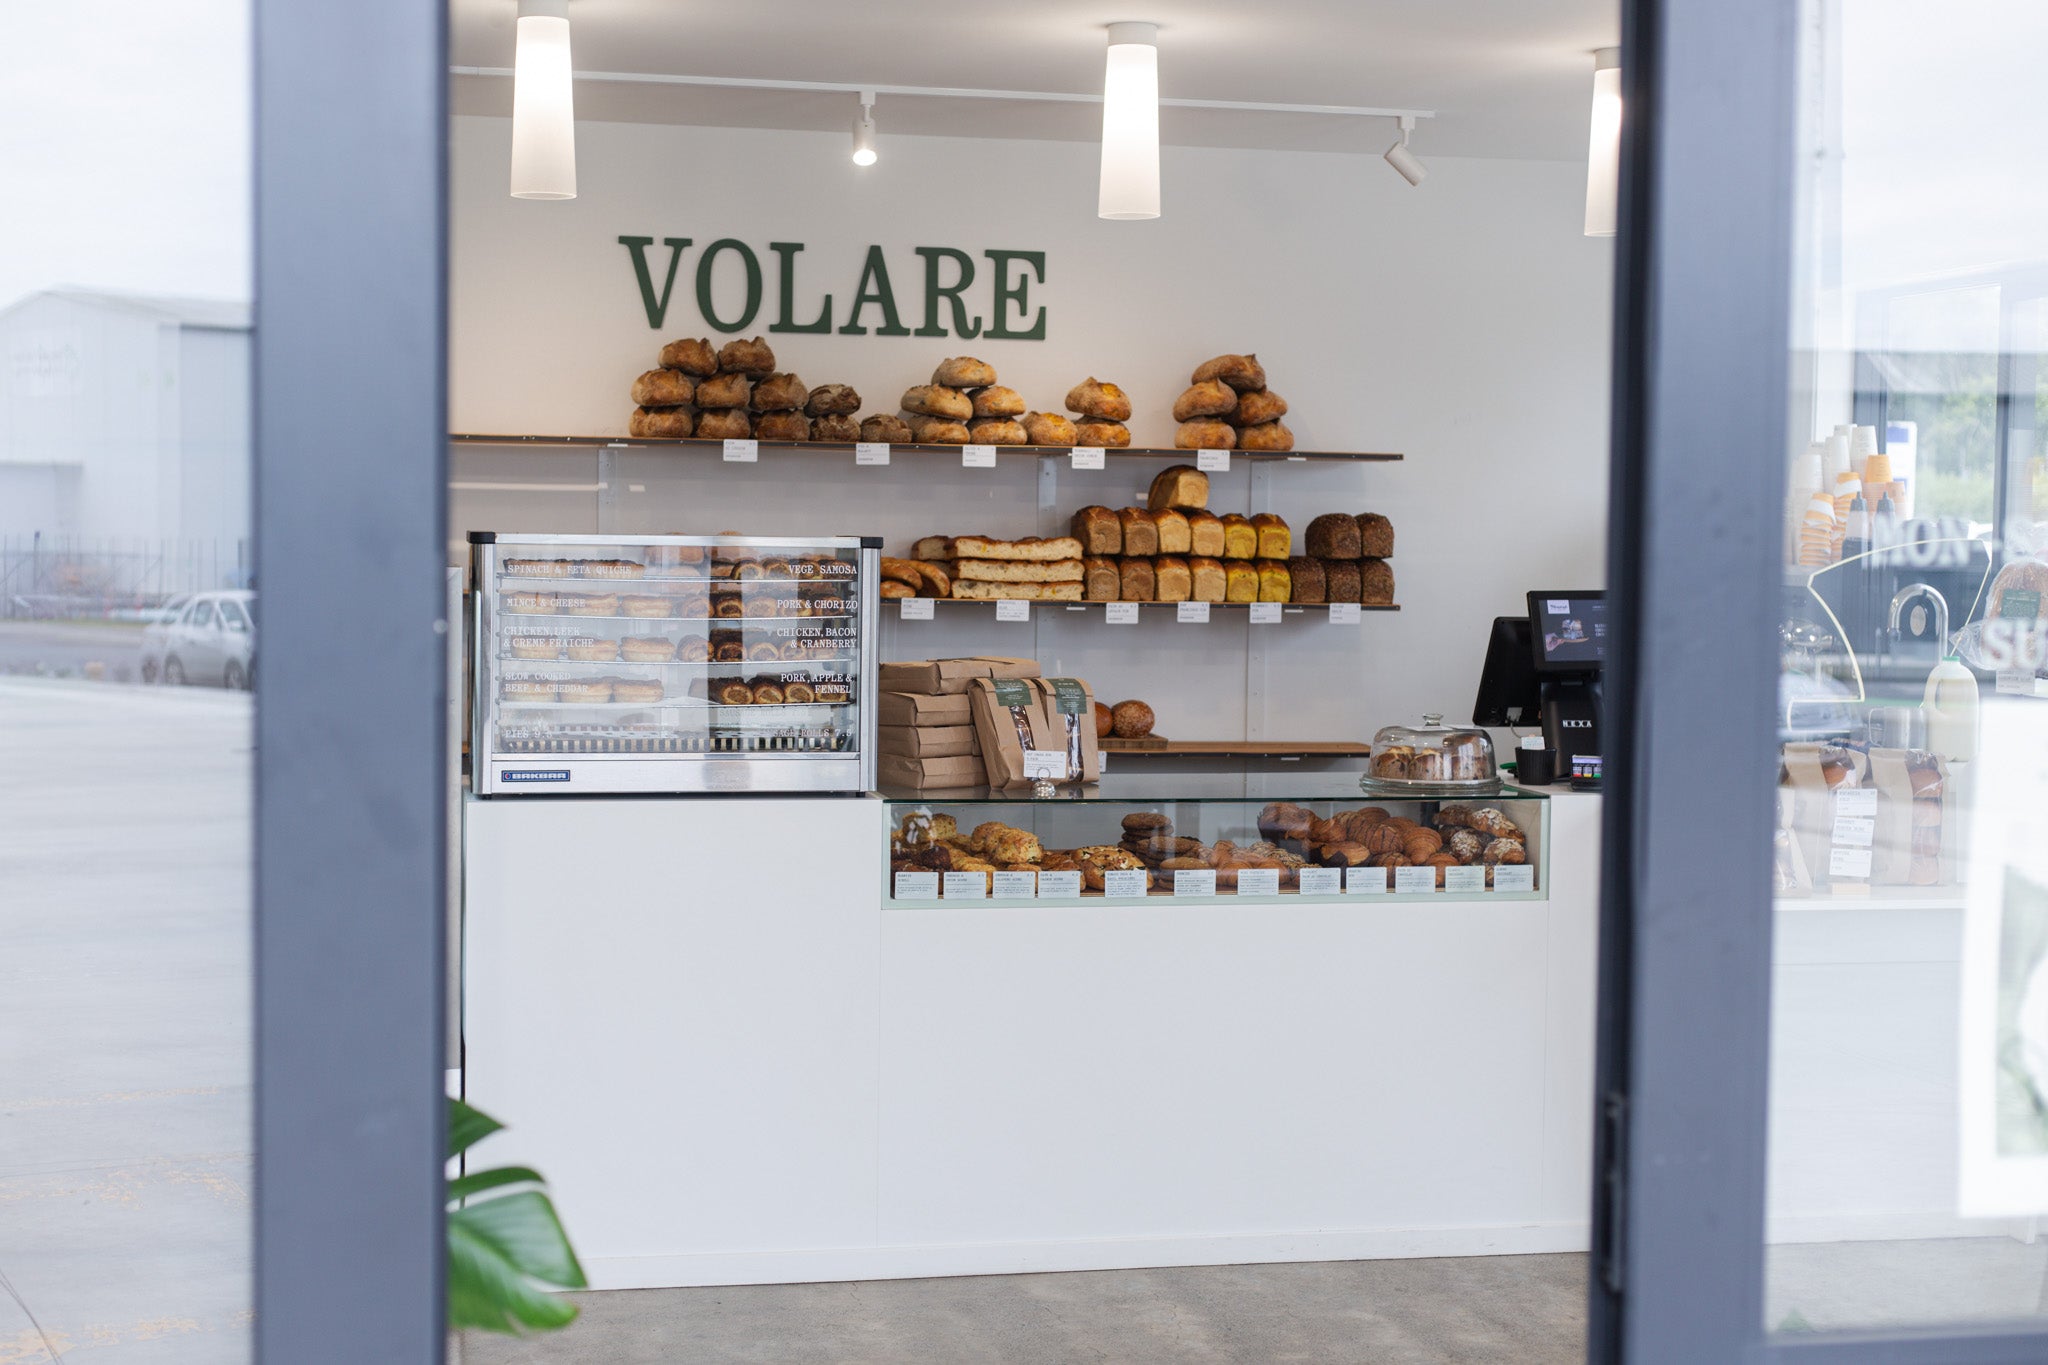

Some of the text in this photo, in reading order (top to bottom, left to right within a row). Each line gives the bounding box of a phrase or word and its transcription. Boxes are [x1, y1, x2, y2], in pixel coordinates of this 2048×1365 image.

[618, 235, 1046, 340] VOLARE
[507, 565, 632, 575] SPINACH & FETA QUICHE
[788, 565, 858, 575] VEGE SAMOSA
[507, 598, 586, 608] MINCE & CHEESE
[777, 599, 858, 609] PORK & CHORIZO
[777, 627, 857, 638] CHICKEN, BACON
[503, 638, 511, 648] &
[549, 638, 594, 648] FRAICHE
[790, 639, 857, 648] & CRANBERRY
[505, 672, 571, 681] SLOW COOKED
[812, 673, 843, 683] APPLE
[845, 674, 852, 683] &
[505, 684, 589, 693] BEEF & CHEDDAR
[814, 684, 852, 694] FENNEL
[505, 729, 529, 739] PIES
[801, 728, 830, 738] ROLLS
